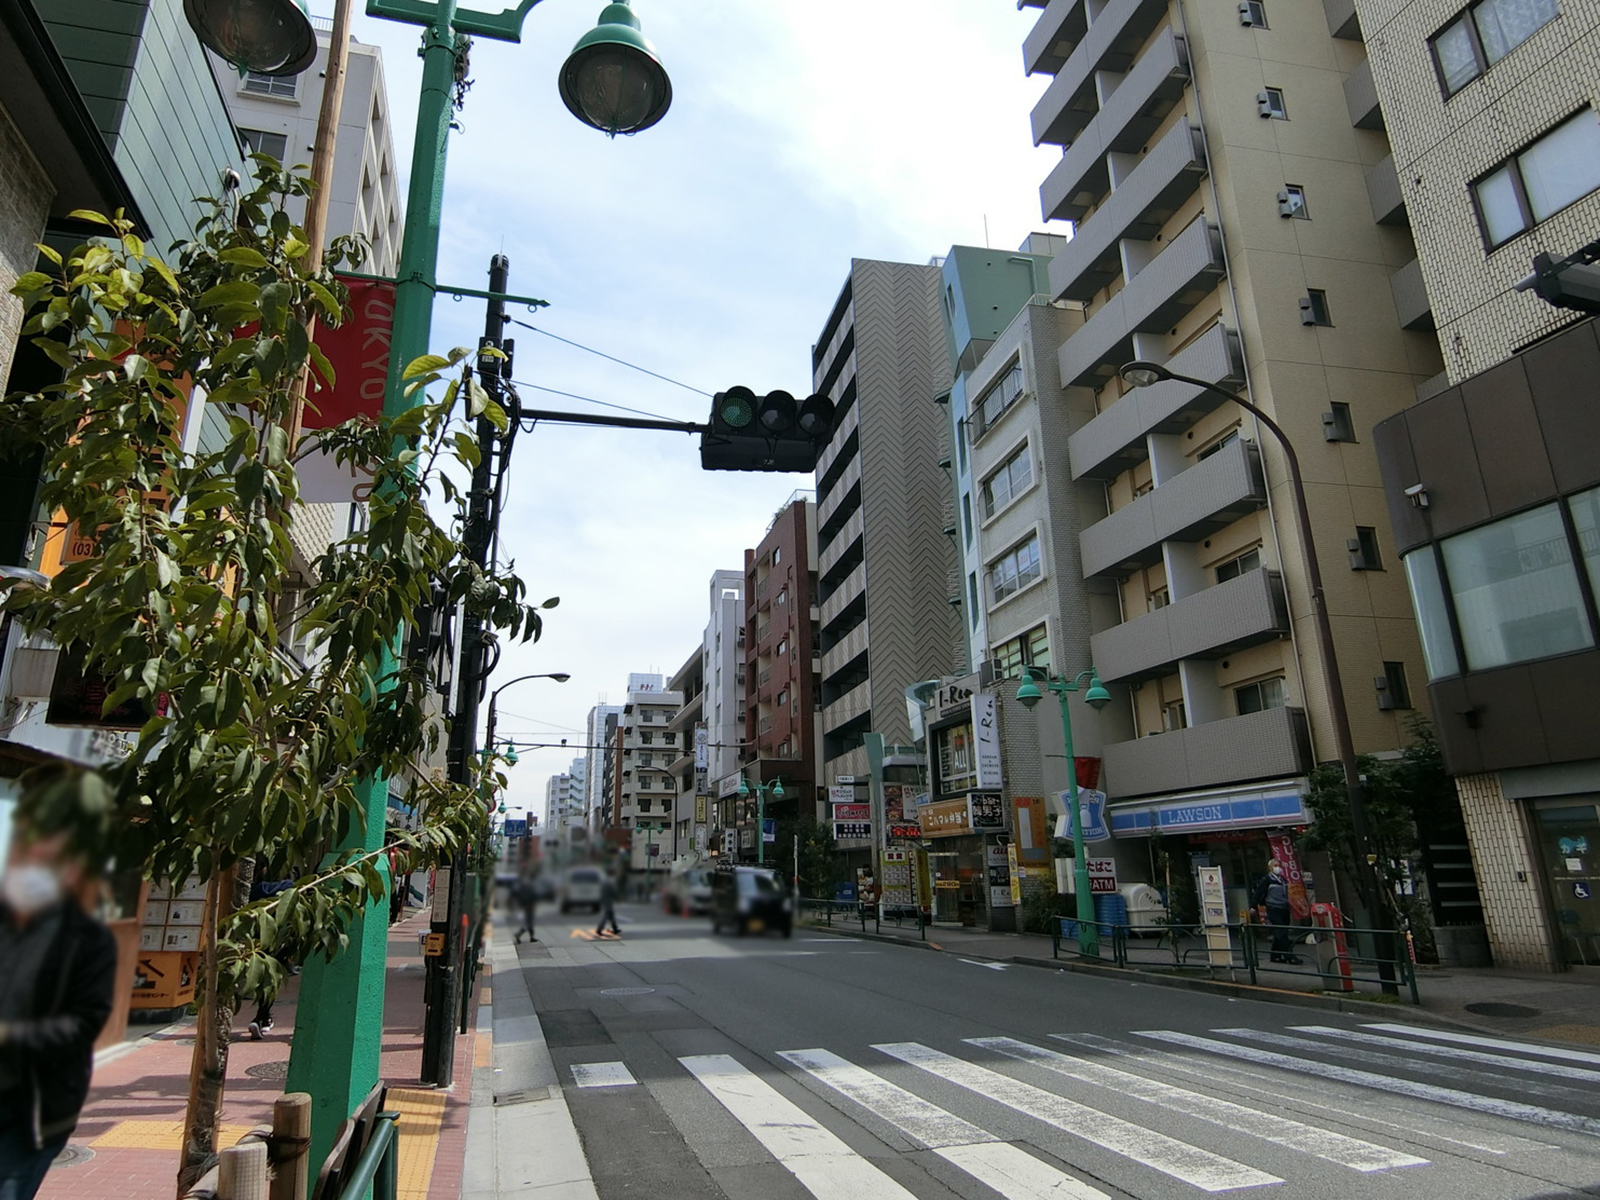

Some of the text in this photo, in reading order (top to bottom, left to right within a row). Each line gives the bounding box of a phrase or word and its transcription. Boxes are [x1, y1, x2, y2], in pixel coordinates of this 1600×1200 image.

[1167, 805, 1223, 824] LAWSON
[1086, 860, 1113, 872] たばこ
